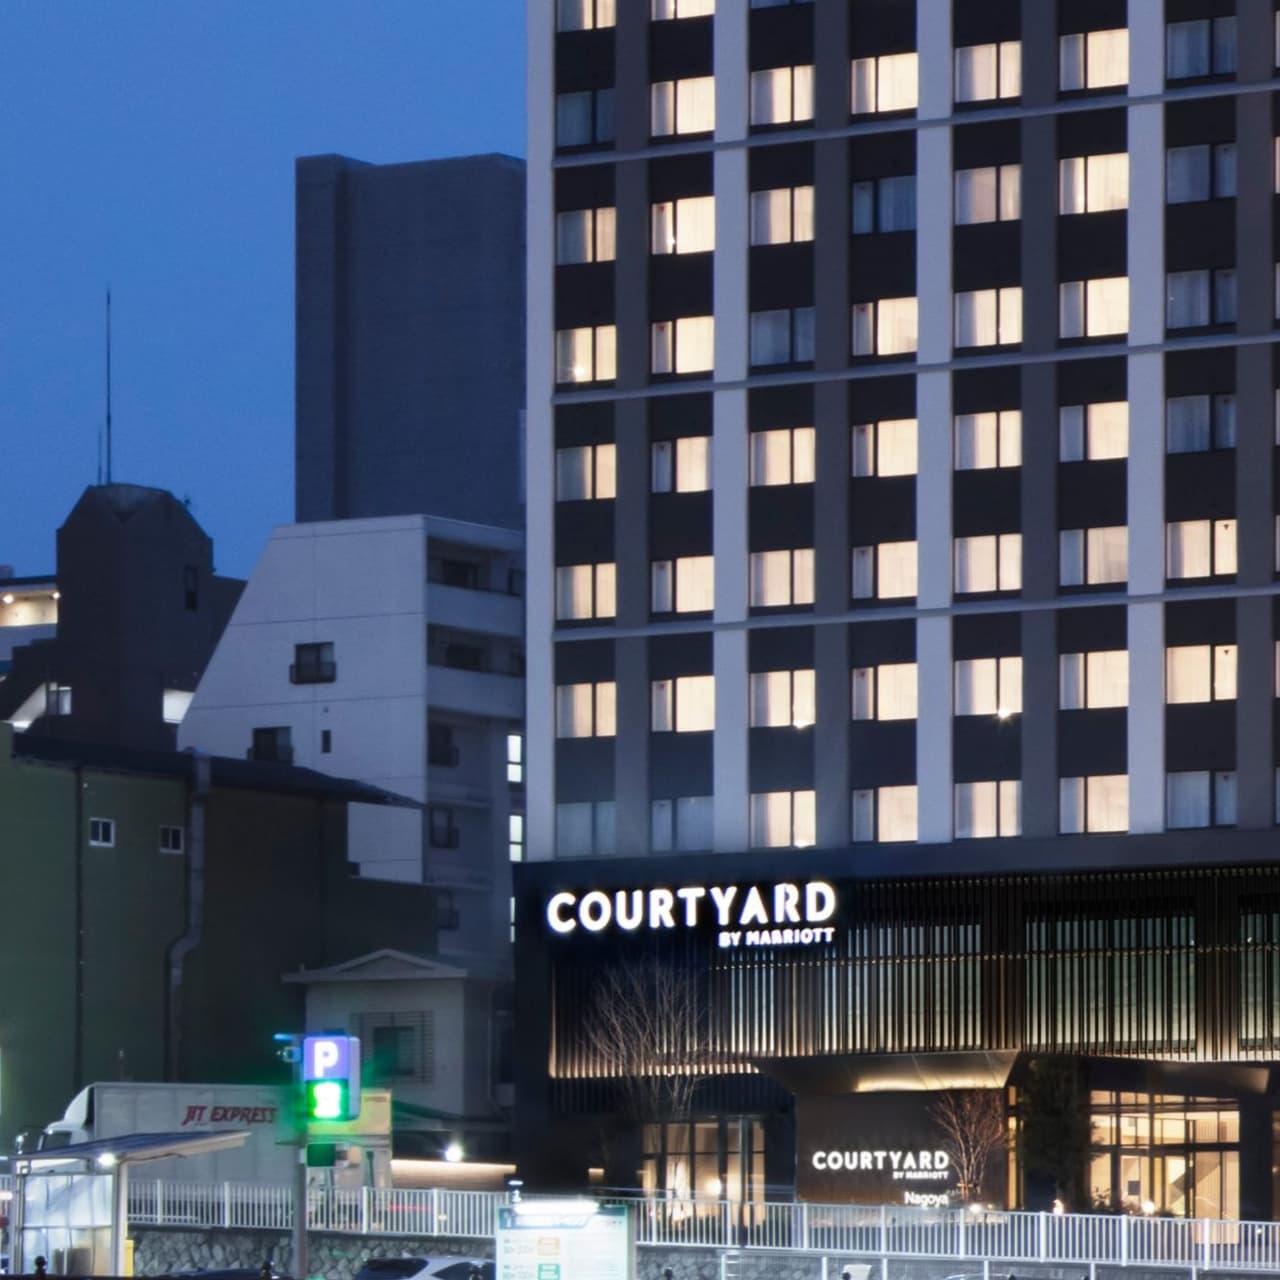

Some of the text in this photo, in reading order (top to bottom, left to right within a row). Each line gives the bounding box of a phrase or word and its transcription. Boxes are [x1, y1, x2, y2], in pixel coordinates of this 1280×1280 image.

[546, 881, 836, 933] COURTYARD
[718, 927, 836, 947] BY MARRIOTT
[314, 1040, 339, 1078] P
[209, 1106, 279, 1126] EXPRESS
[811, 1150, 950, 1171] COURTYARD
[893, 1171, 949, 1179] BY MARRIOTT
[904, 1191, 949, 1210] Nagoya
